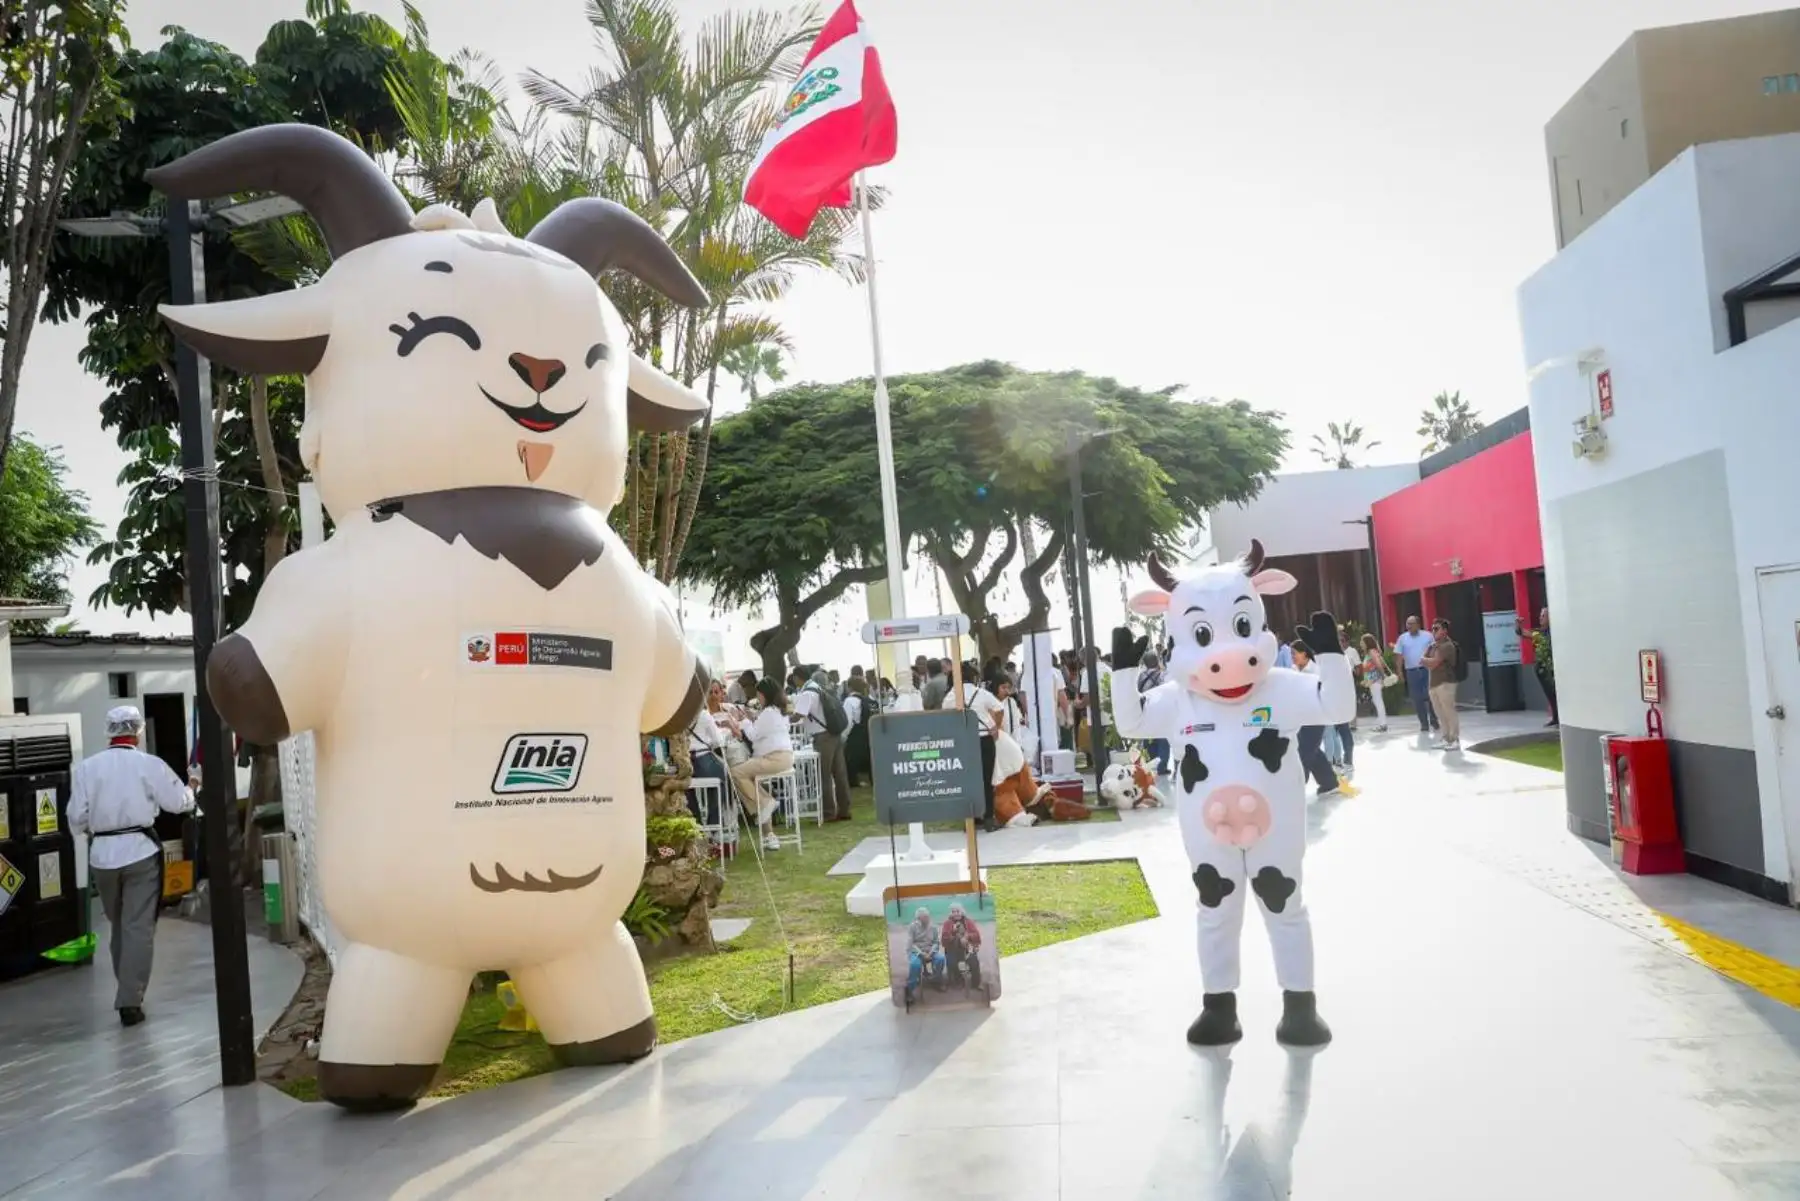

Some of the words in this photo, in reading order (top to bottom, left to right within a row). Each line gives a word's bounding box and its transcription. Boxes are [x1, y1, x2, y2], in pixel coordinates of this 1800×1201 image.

[498, 642, 525, 653] PERÚ
[532, 638, 569, 647] Ministerio
[511, 739, 577, 768] inia
[892, 758, 963, 774] HISTORIA
[454, 800, 493, 809] Instituto
[495, 796, 534, 807] Nacional
[536, 796, 547, 804] de
